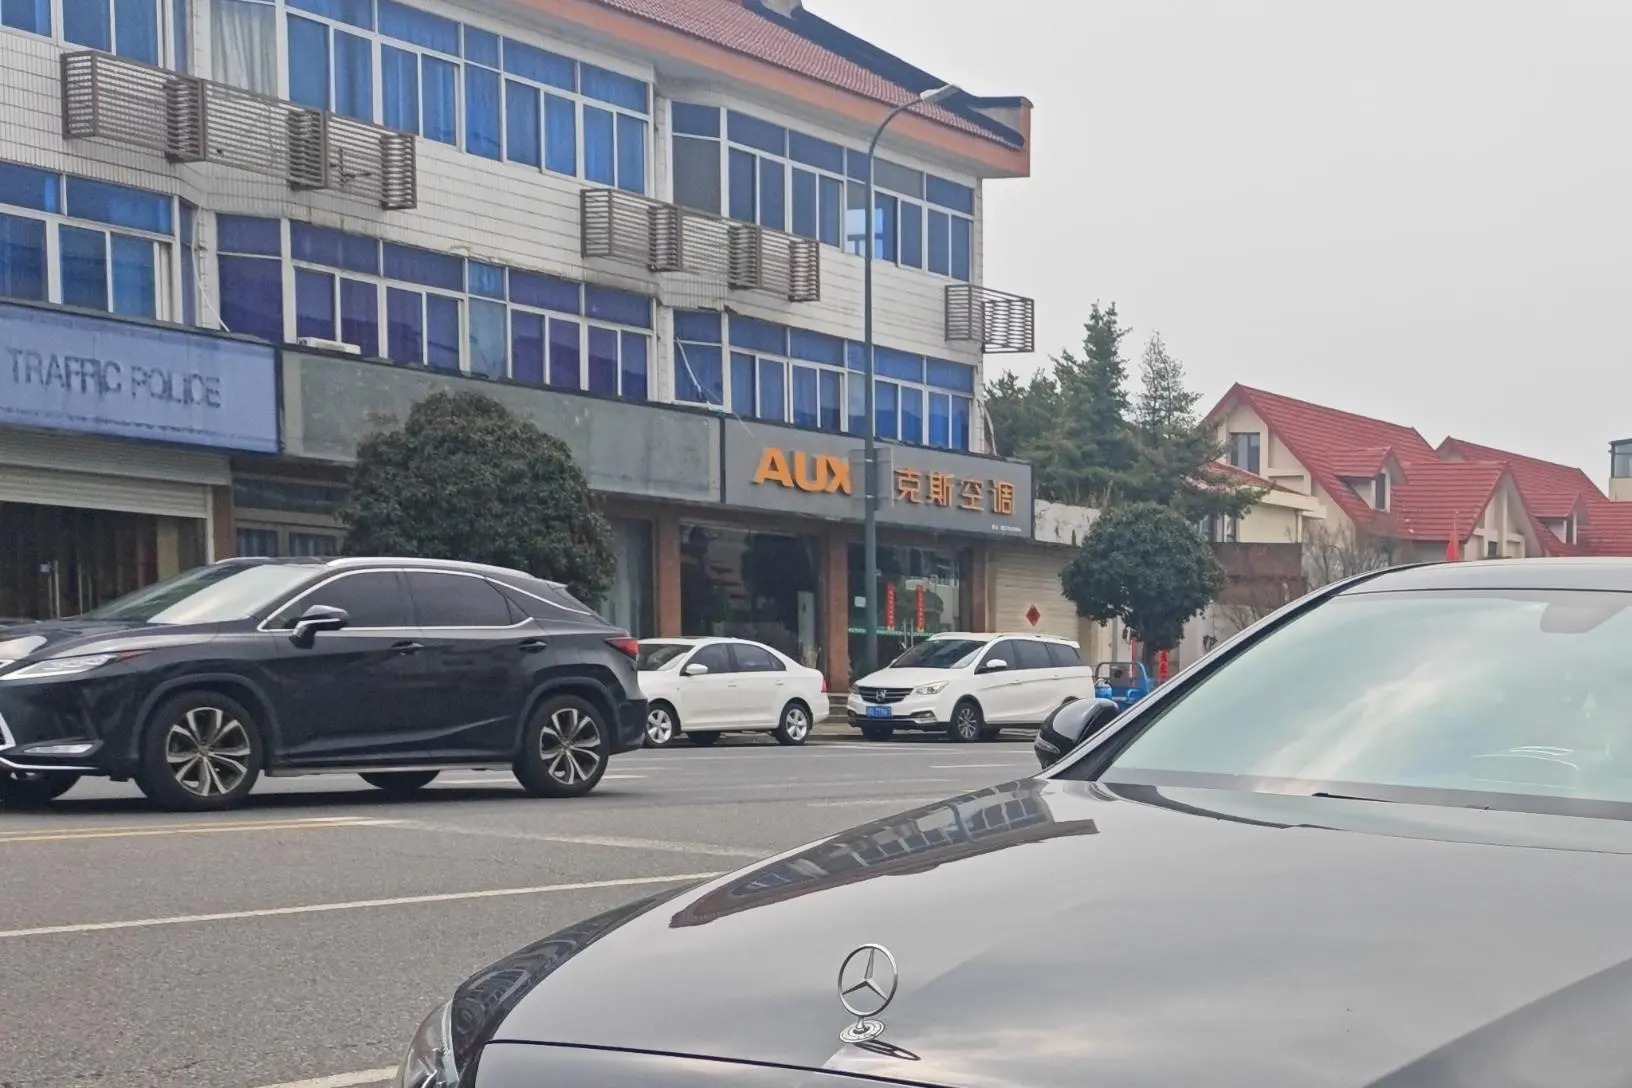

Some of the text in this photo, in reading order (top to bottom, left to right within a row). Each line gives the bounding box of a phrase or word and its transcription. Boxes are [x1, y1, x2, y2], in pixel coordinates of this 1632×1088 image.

[8, 349, 221, 409] TRAFFIC POLICE
[753, 447, 850, 494] AUX
